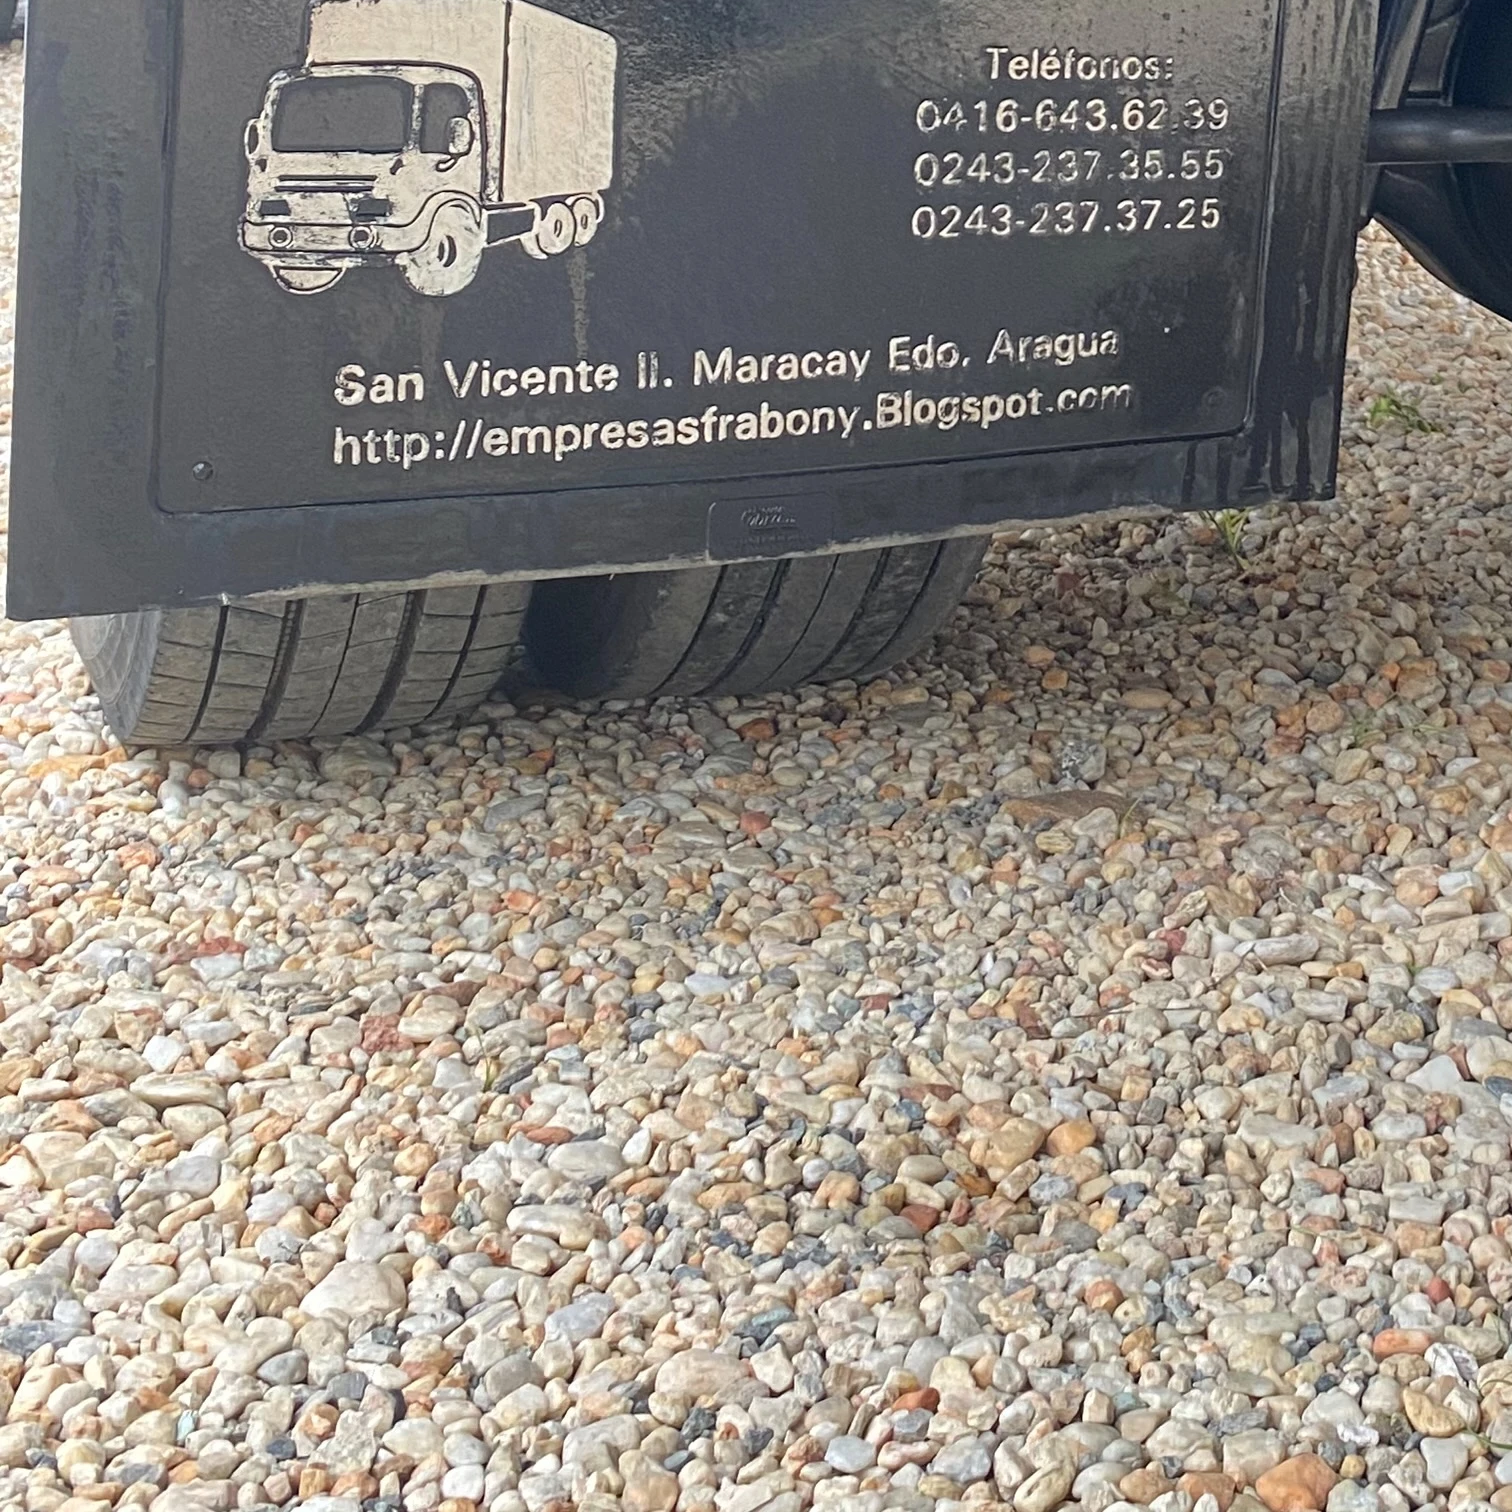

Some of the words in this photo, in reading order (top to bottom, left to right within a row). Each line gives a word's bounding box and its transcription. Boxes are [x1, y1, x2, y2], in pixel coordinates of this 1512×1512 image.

[986, 46, 1174, 80] Teléfonos:
[916, 98, 1229, 133] 0416-643.62.39
[914, 150, 1226, 186] 0243-237.35.55
[911, 198, 1220, 238] 0243-237.37.25
[333, 364, 425, 406] San
[443, 359, 619, 398] Vicente
[693, 346, 870, 388] Maracay
[986, 328, 1119, 366] Aragua
[332, 384, 1133, 470] http://empresasfrabony.Blogspot.com
